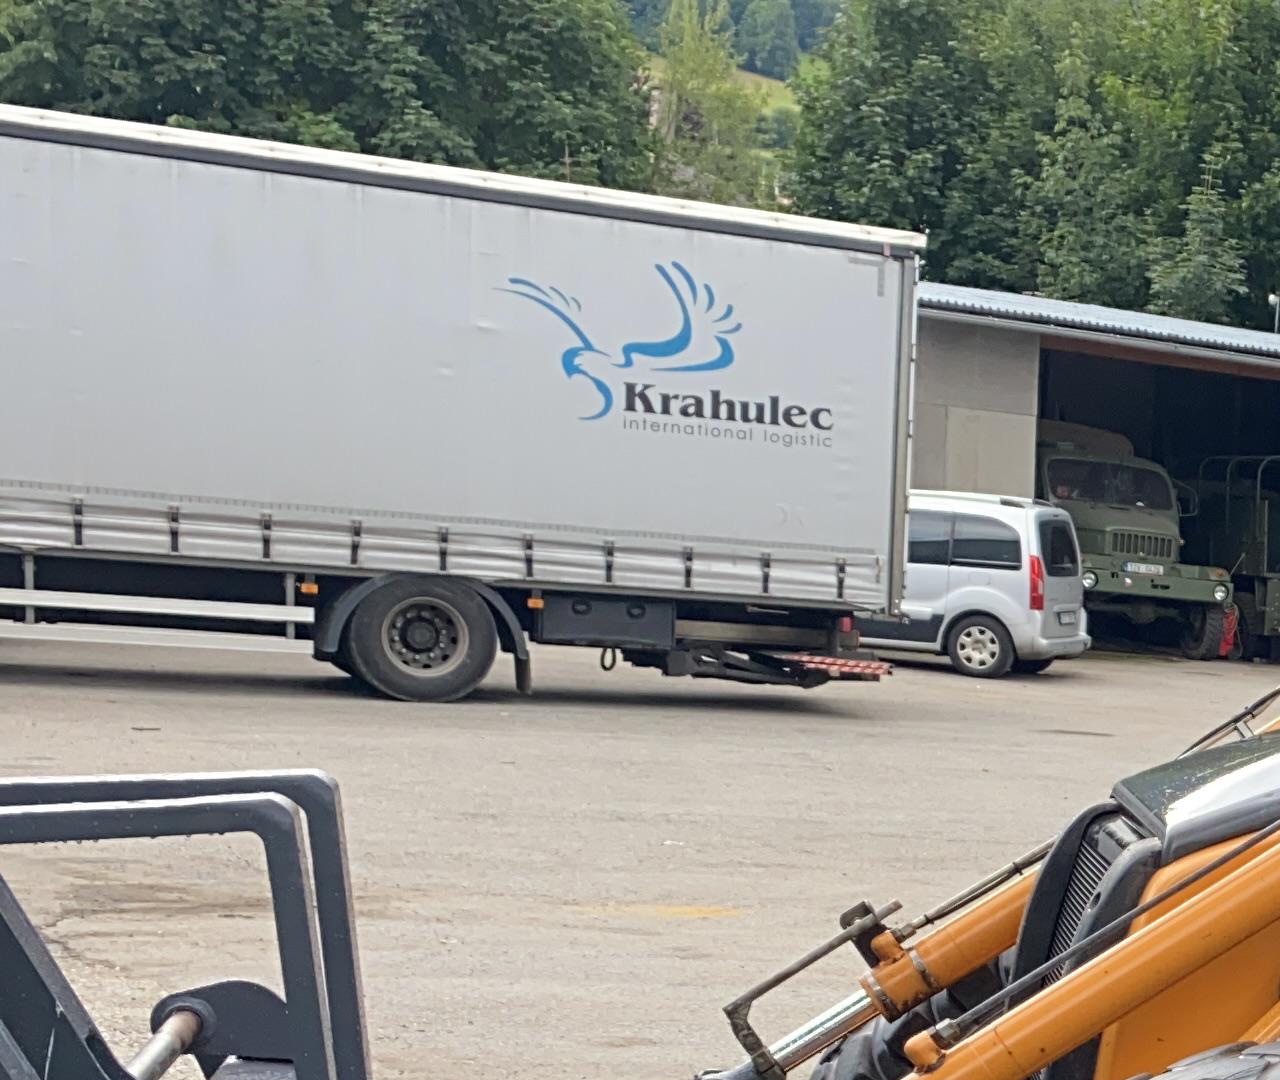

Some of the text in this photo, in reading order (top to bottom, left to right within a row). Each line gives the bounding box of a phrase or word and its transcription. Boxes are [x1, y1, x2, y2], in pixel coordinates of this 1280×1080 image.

[623, 381, 834, 431] Krahulec
[623, 415, 833, 448] international logistic
